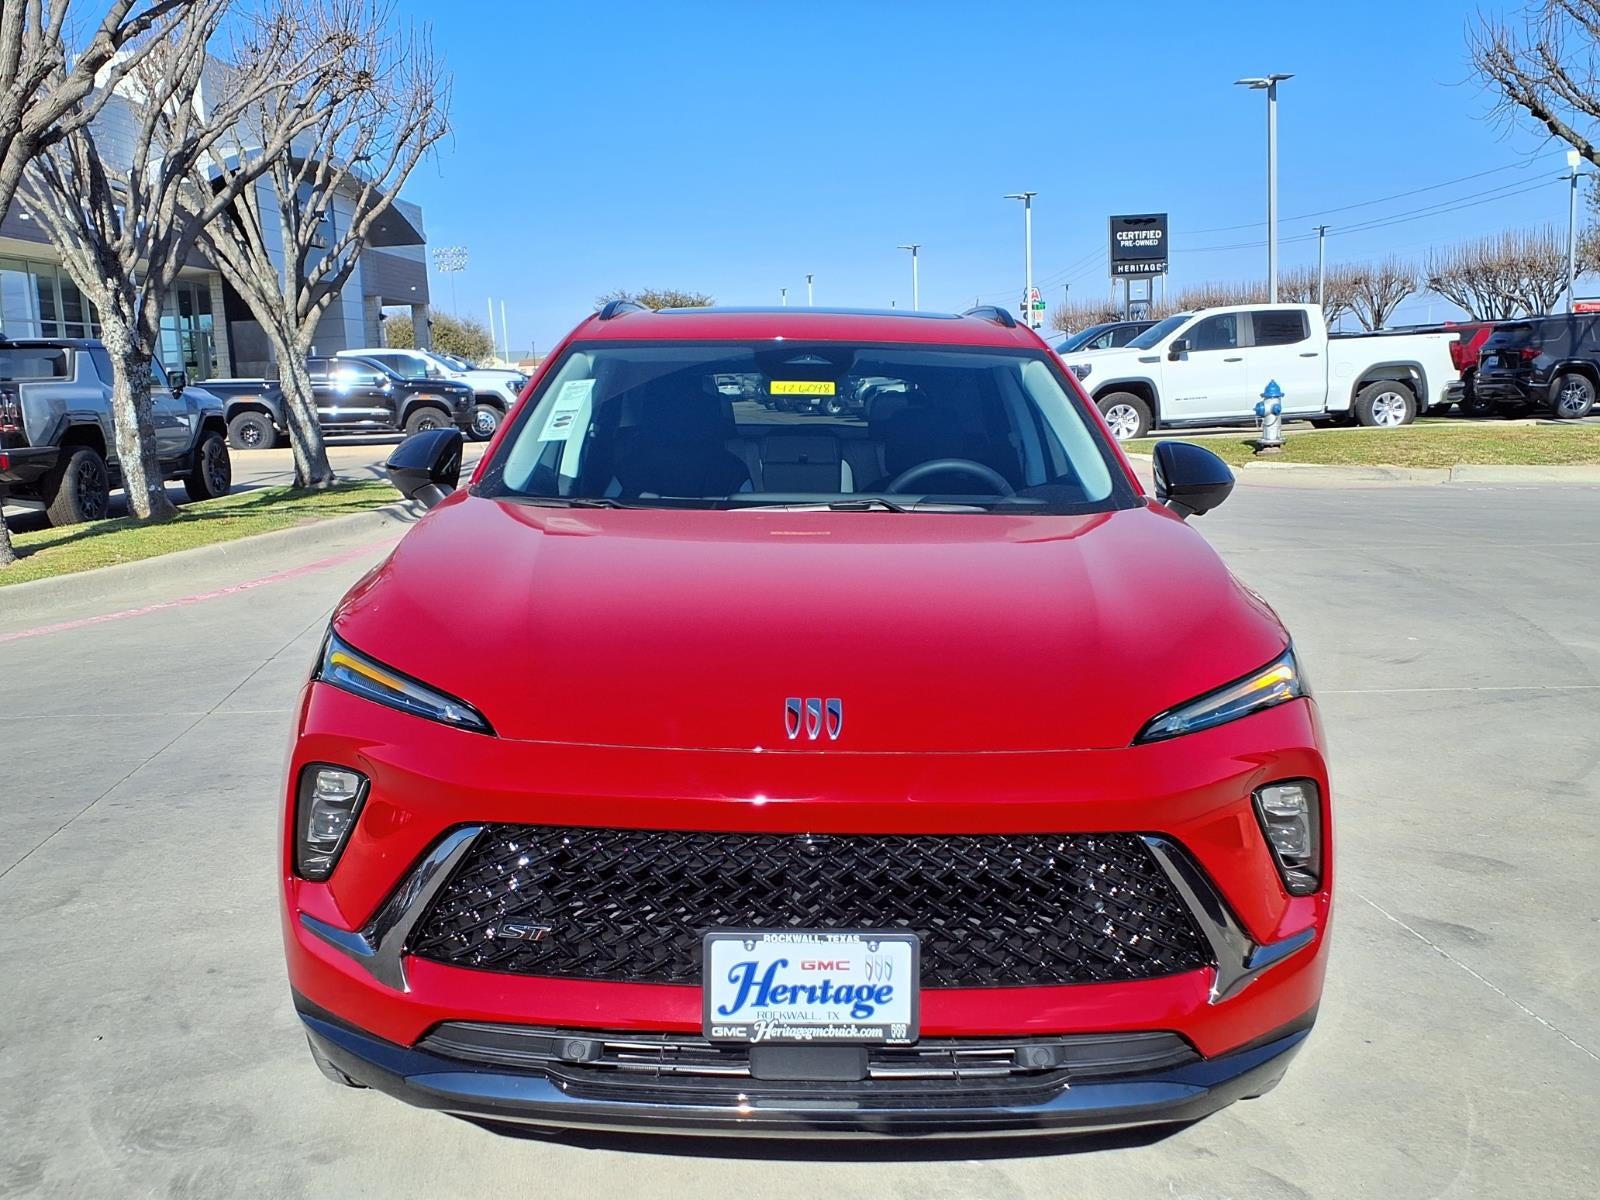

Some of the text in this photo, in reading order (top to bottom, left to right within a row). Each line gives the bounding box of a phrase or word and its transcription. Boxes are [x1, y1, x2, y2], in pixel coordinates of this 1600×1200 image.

[1116, 230, 1162, 240] CERTIFIED
[1118, 264, 1162, 272] HERITAGE
[498, 923, 552, 941] ST
[763, 934, 860, 945] ROCKWALL, TEXAS
[801, 960, 850, 971] GMC
[717, 958, 893, 1019] Heritage
[827, 1011, 840, 1020] TX
[711, 1027, 747, 1036] GMC
[750, 1019, 883, 1043] Heritagegmcbuick.com
